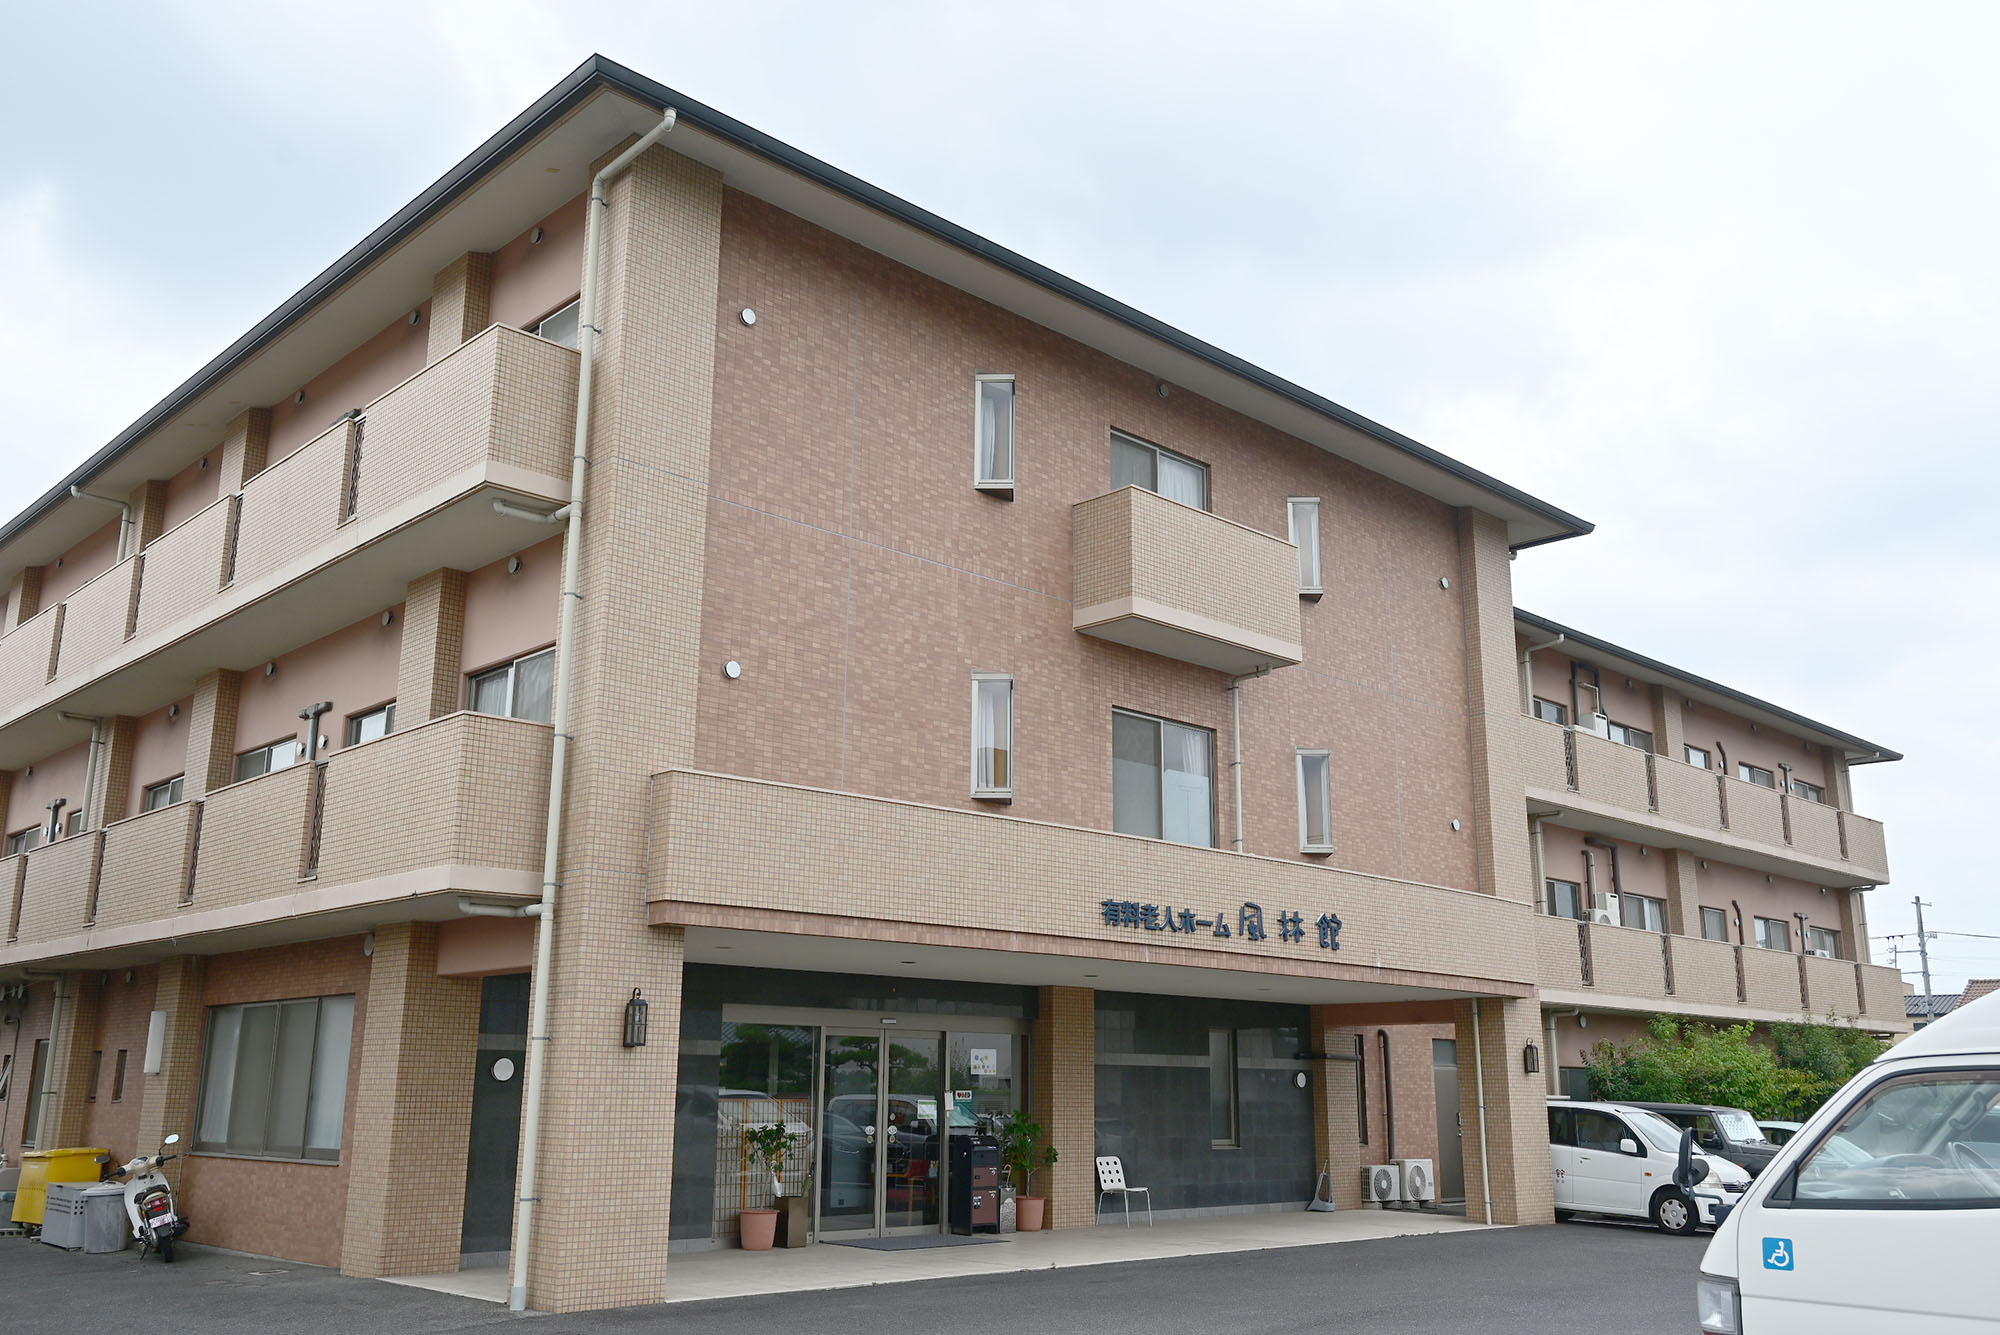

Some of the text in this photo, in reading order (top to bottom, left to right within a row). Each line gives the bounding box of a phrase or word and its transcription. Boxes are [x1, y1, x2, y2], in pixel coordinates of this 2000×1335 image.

[1101, 898, 1342, 950] 有料老人ホーム 風林館
